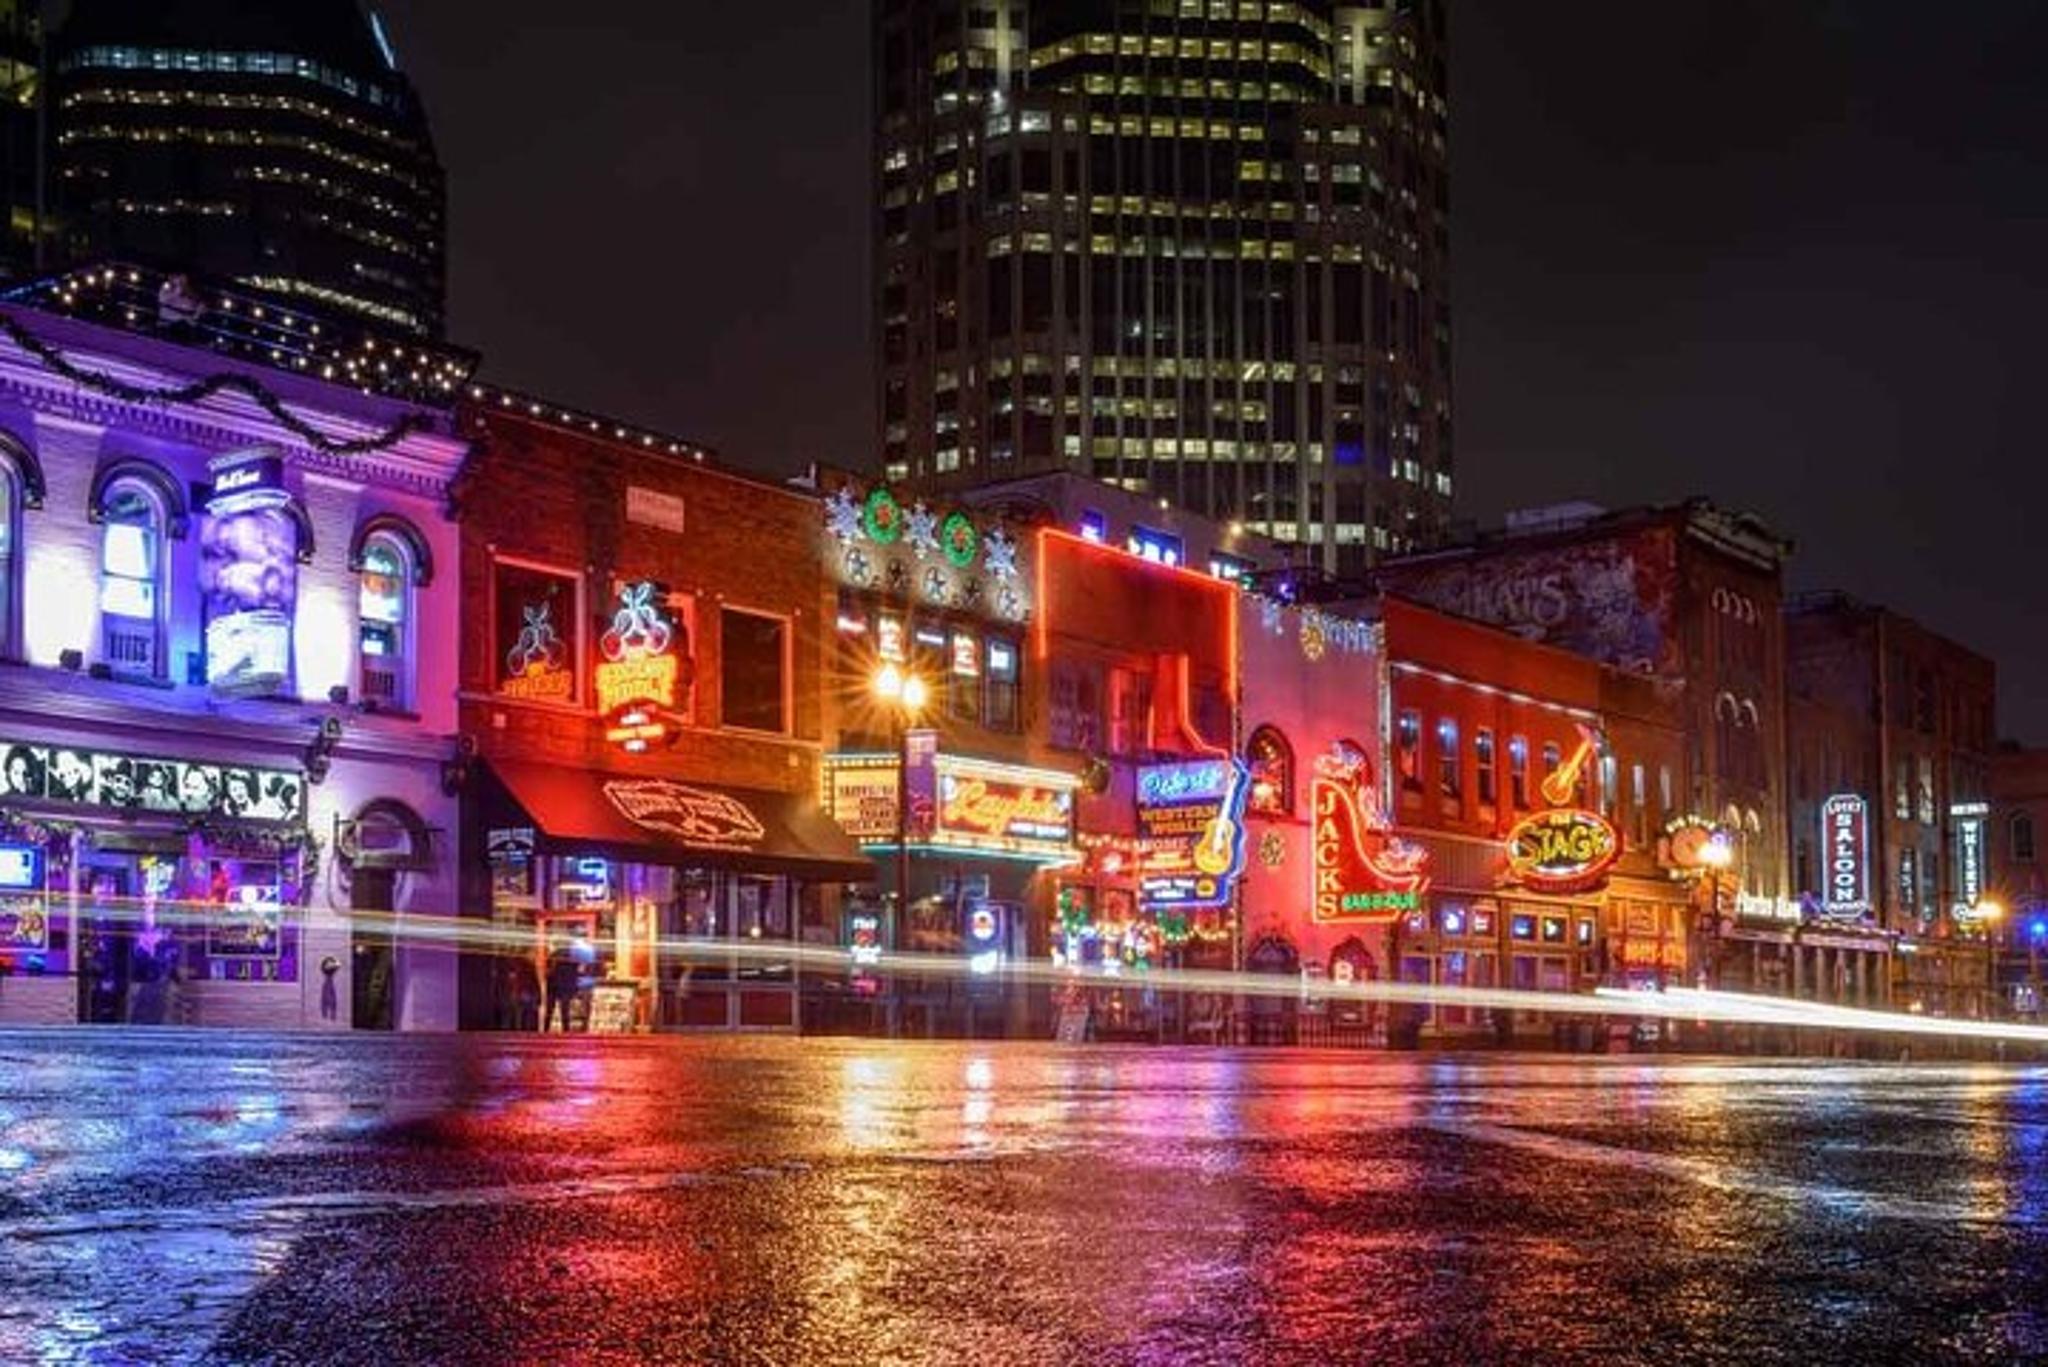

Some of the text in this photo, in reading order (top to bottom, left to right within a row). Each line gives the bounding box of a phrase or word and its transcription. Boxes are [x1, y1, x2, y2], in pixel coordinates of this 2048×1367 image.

[1140, 806, 1219, 822] WESTERN
[1513, 821, 1606, 868] STAGE
[1317, 791, 1344, 918] JACKS
[1833, 813, 1856, 902] SALOON
